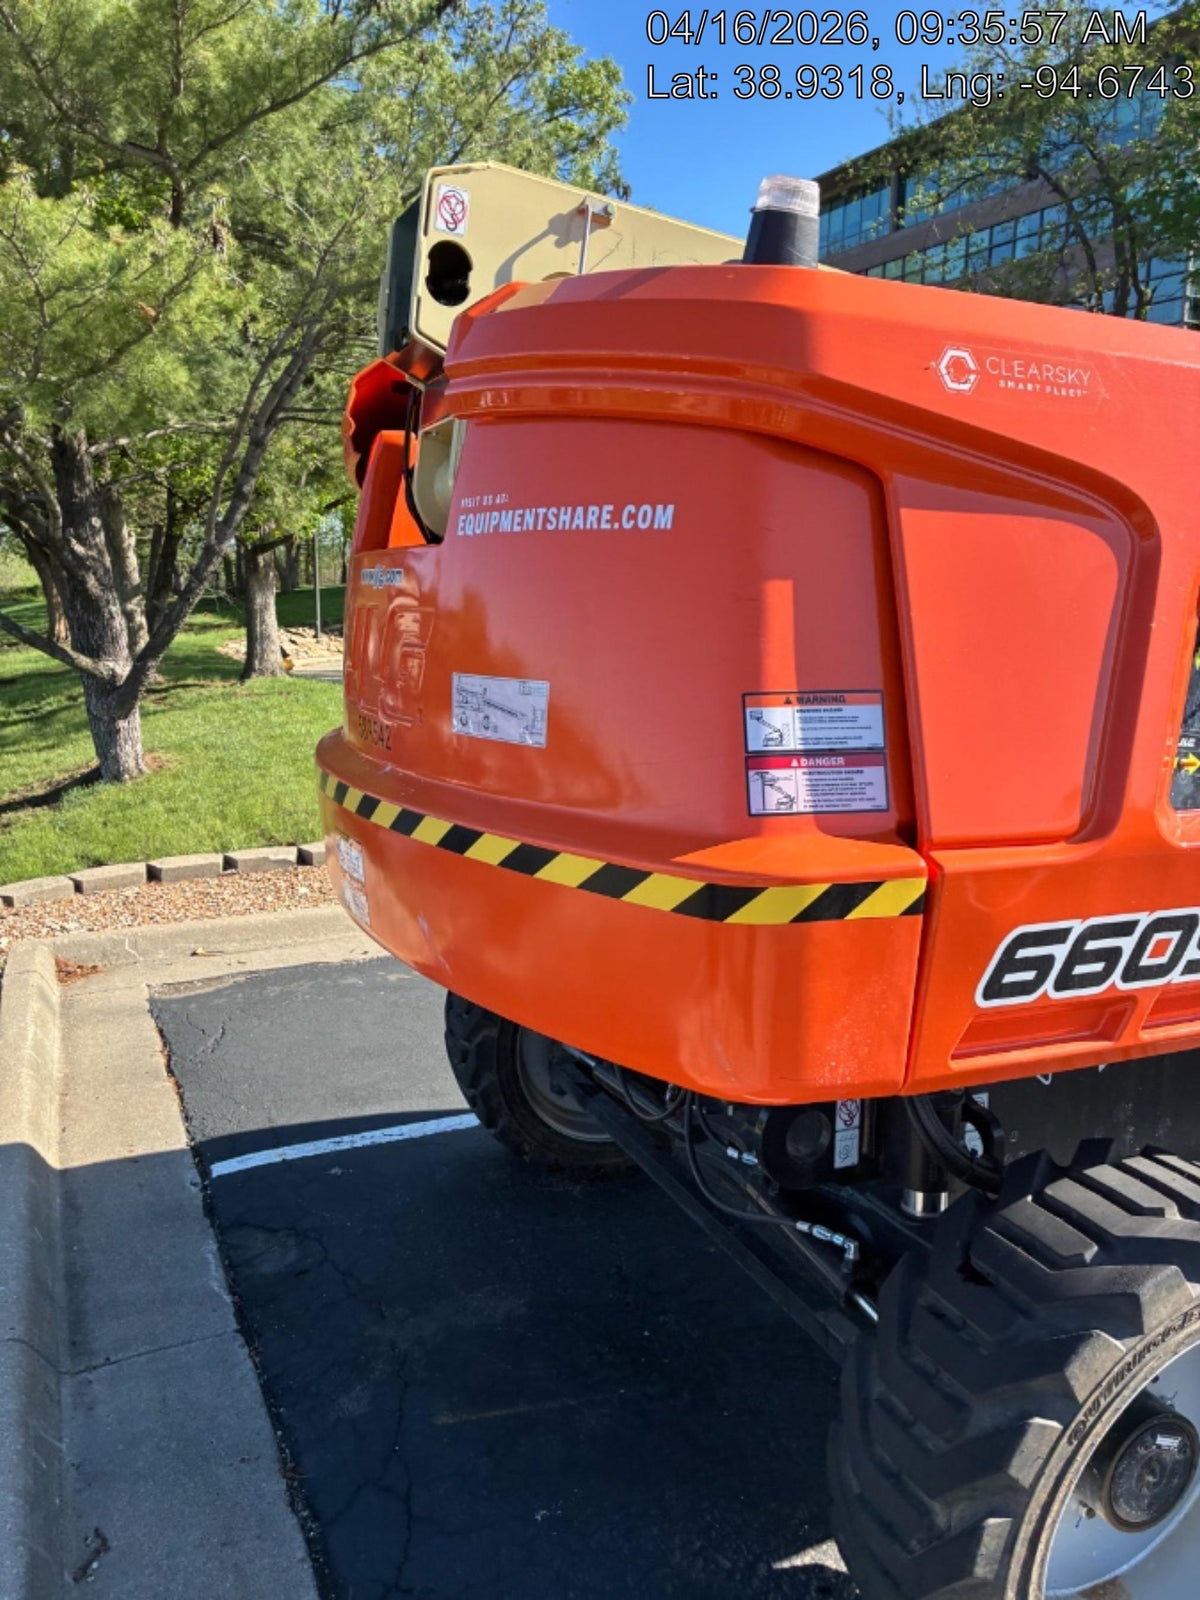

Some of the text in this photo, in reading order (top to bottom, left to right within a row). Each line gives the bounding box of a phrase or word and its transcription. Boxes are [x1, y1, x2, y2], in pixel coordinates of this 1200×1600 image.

[985, 356, 1091, 386] CLEARSKY
[457, 504, 675, 536] EQUIPMENTSHARE.COM
[796, 694, 846, 705] WARNING
[799, 756, 846, 767] DANGER
[977, 909, 1200, 1006] 660
